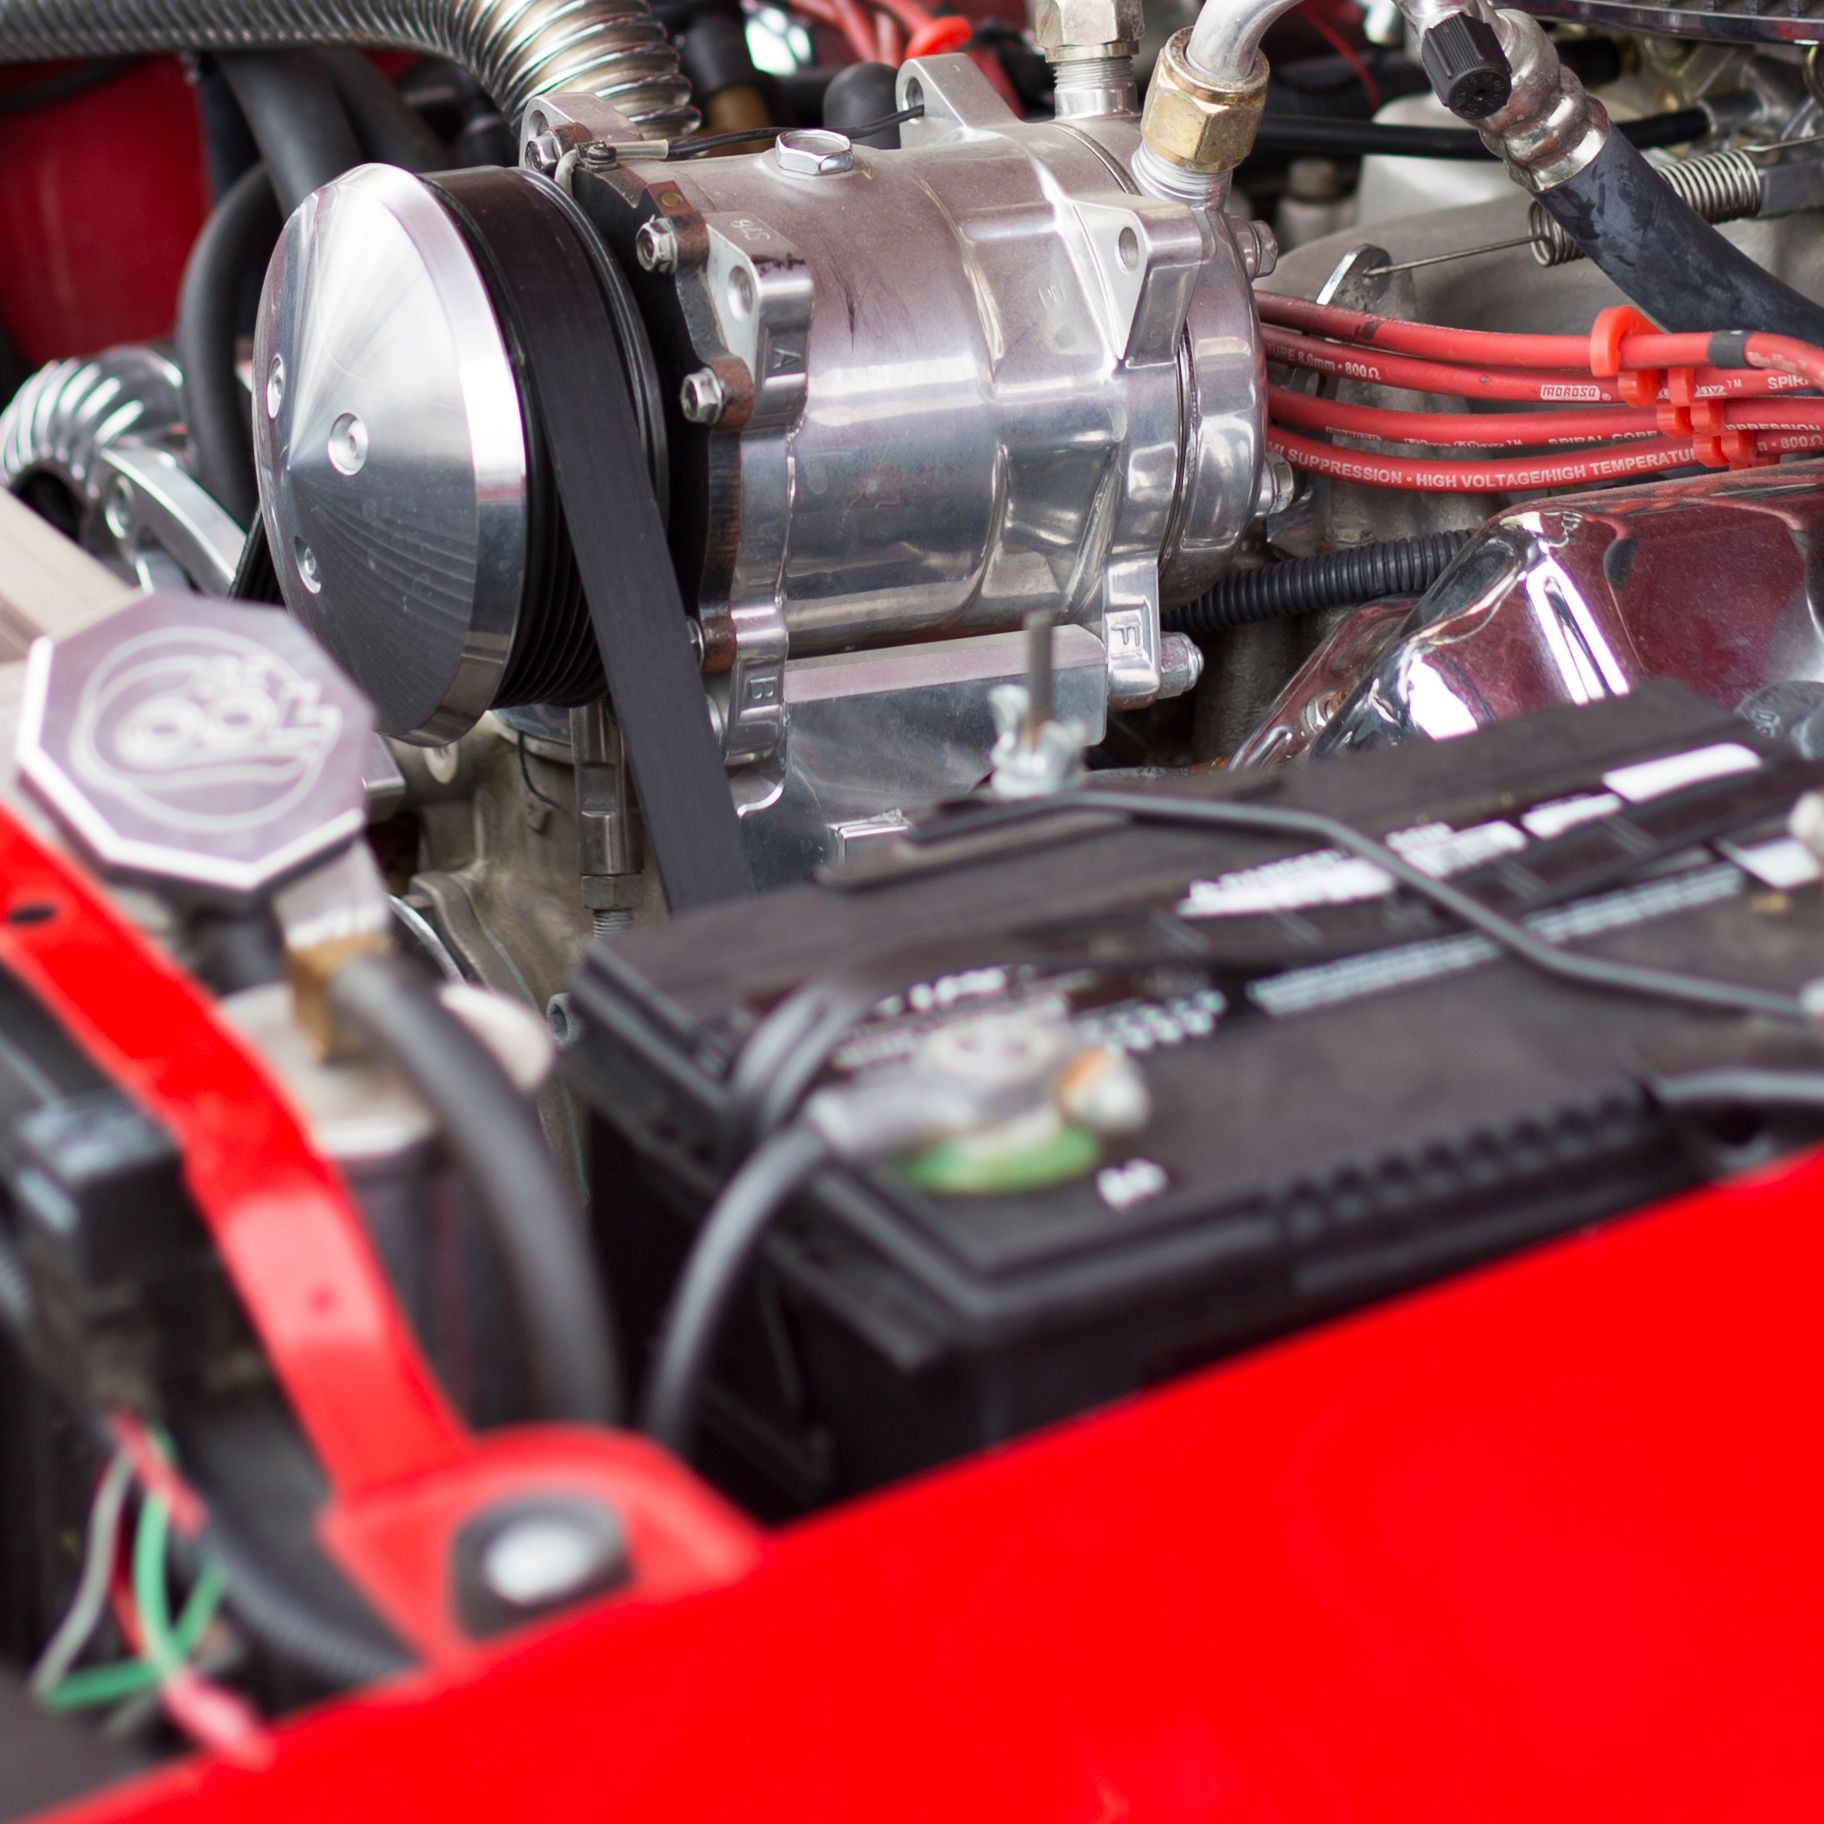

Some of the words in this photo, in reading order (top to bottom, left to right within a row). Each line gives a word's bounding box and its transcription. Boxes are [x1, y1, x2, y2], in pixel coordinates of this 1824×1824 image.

[1284, 448, 1403, 485] SUPPRESSION
[1416, 473, 1457, 488] HIGH
[1460, 464, 1587, 489] VOLTAGE/HIGH
[1590, 447, 1696, 477] TEMPERATU
[1110, 621, 1141, 647] F
